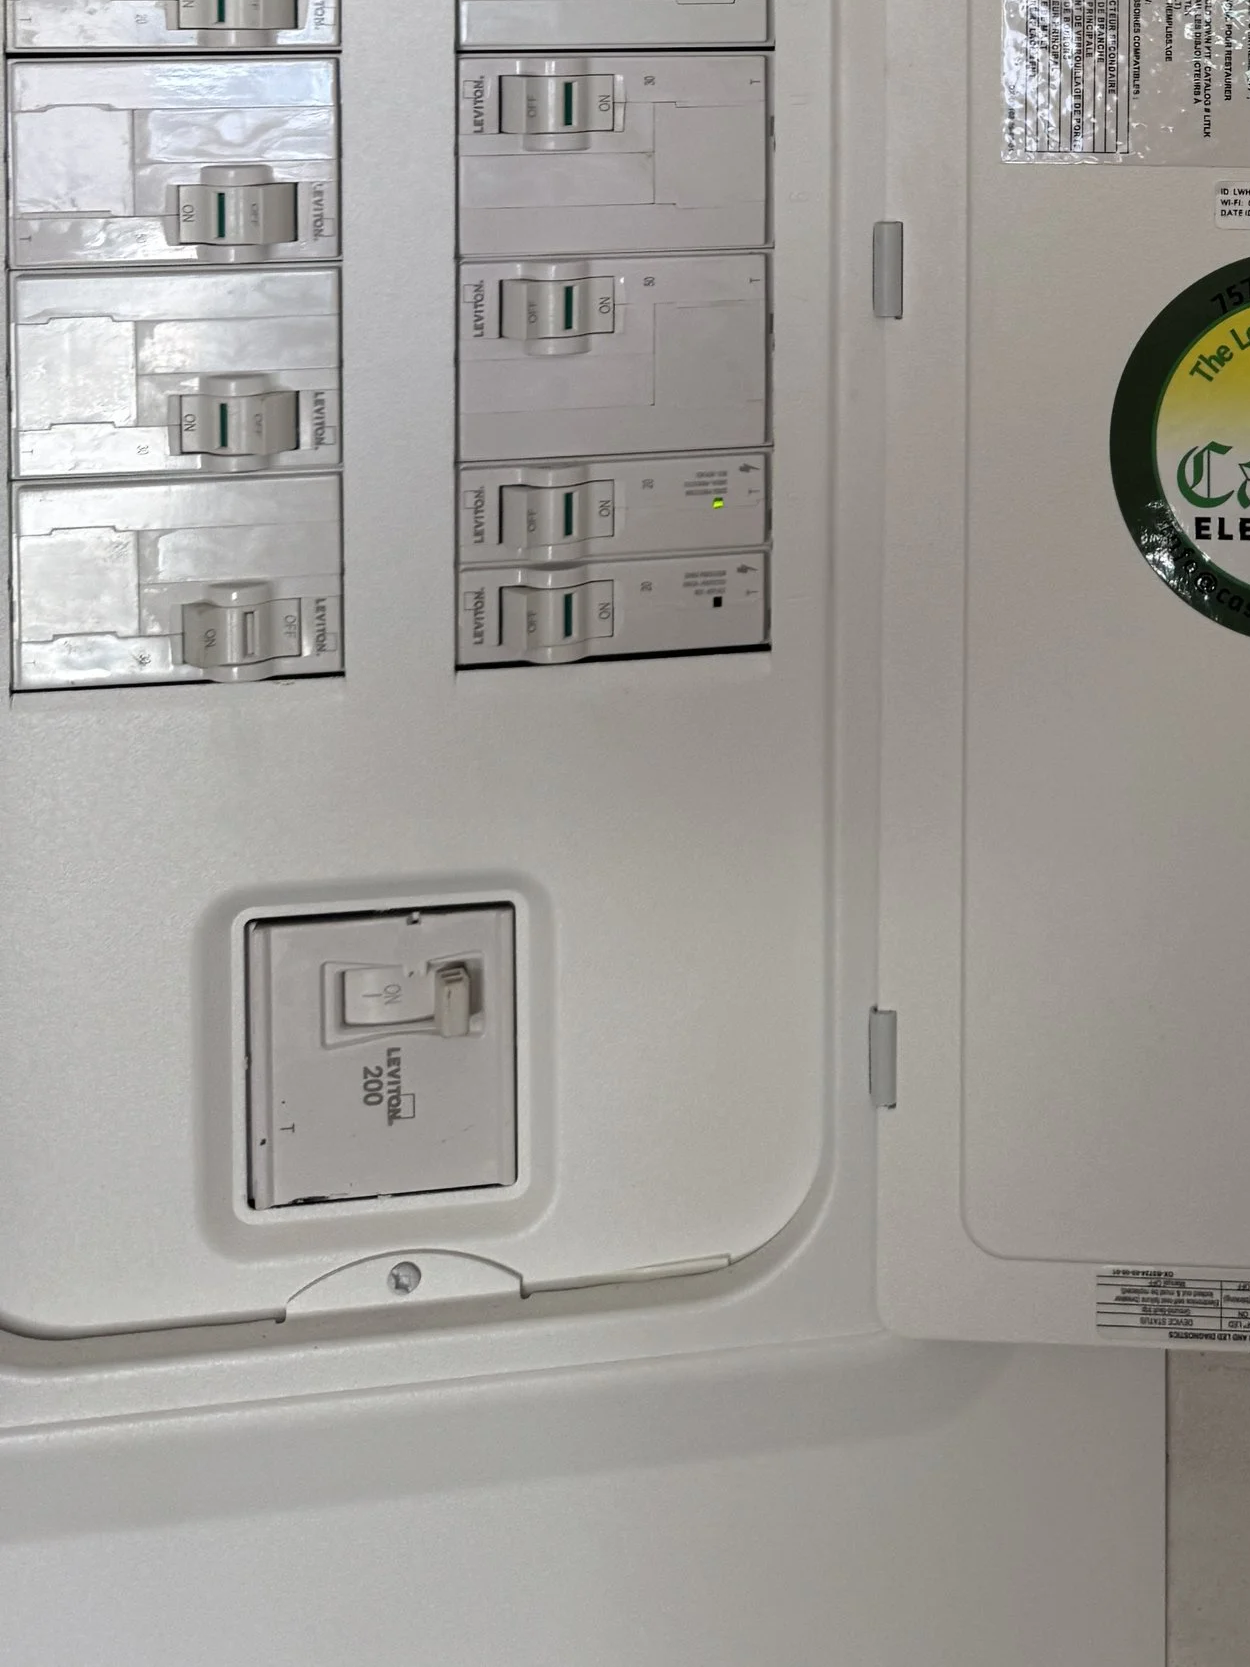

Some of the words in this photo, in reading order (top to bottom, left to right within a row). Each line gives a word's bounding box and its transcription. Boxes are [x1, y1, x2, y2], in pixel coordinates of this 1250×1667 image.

[1190, 344, 1233, 384] The
[384, 984, 402, 1005] ON
[363, 1066, 383, 1107] 200
